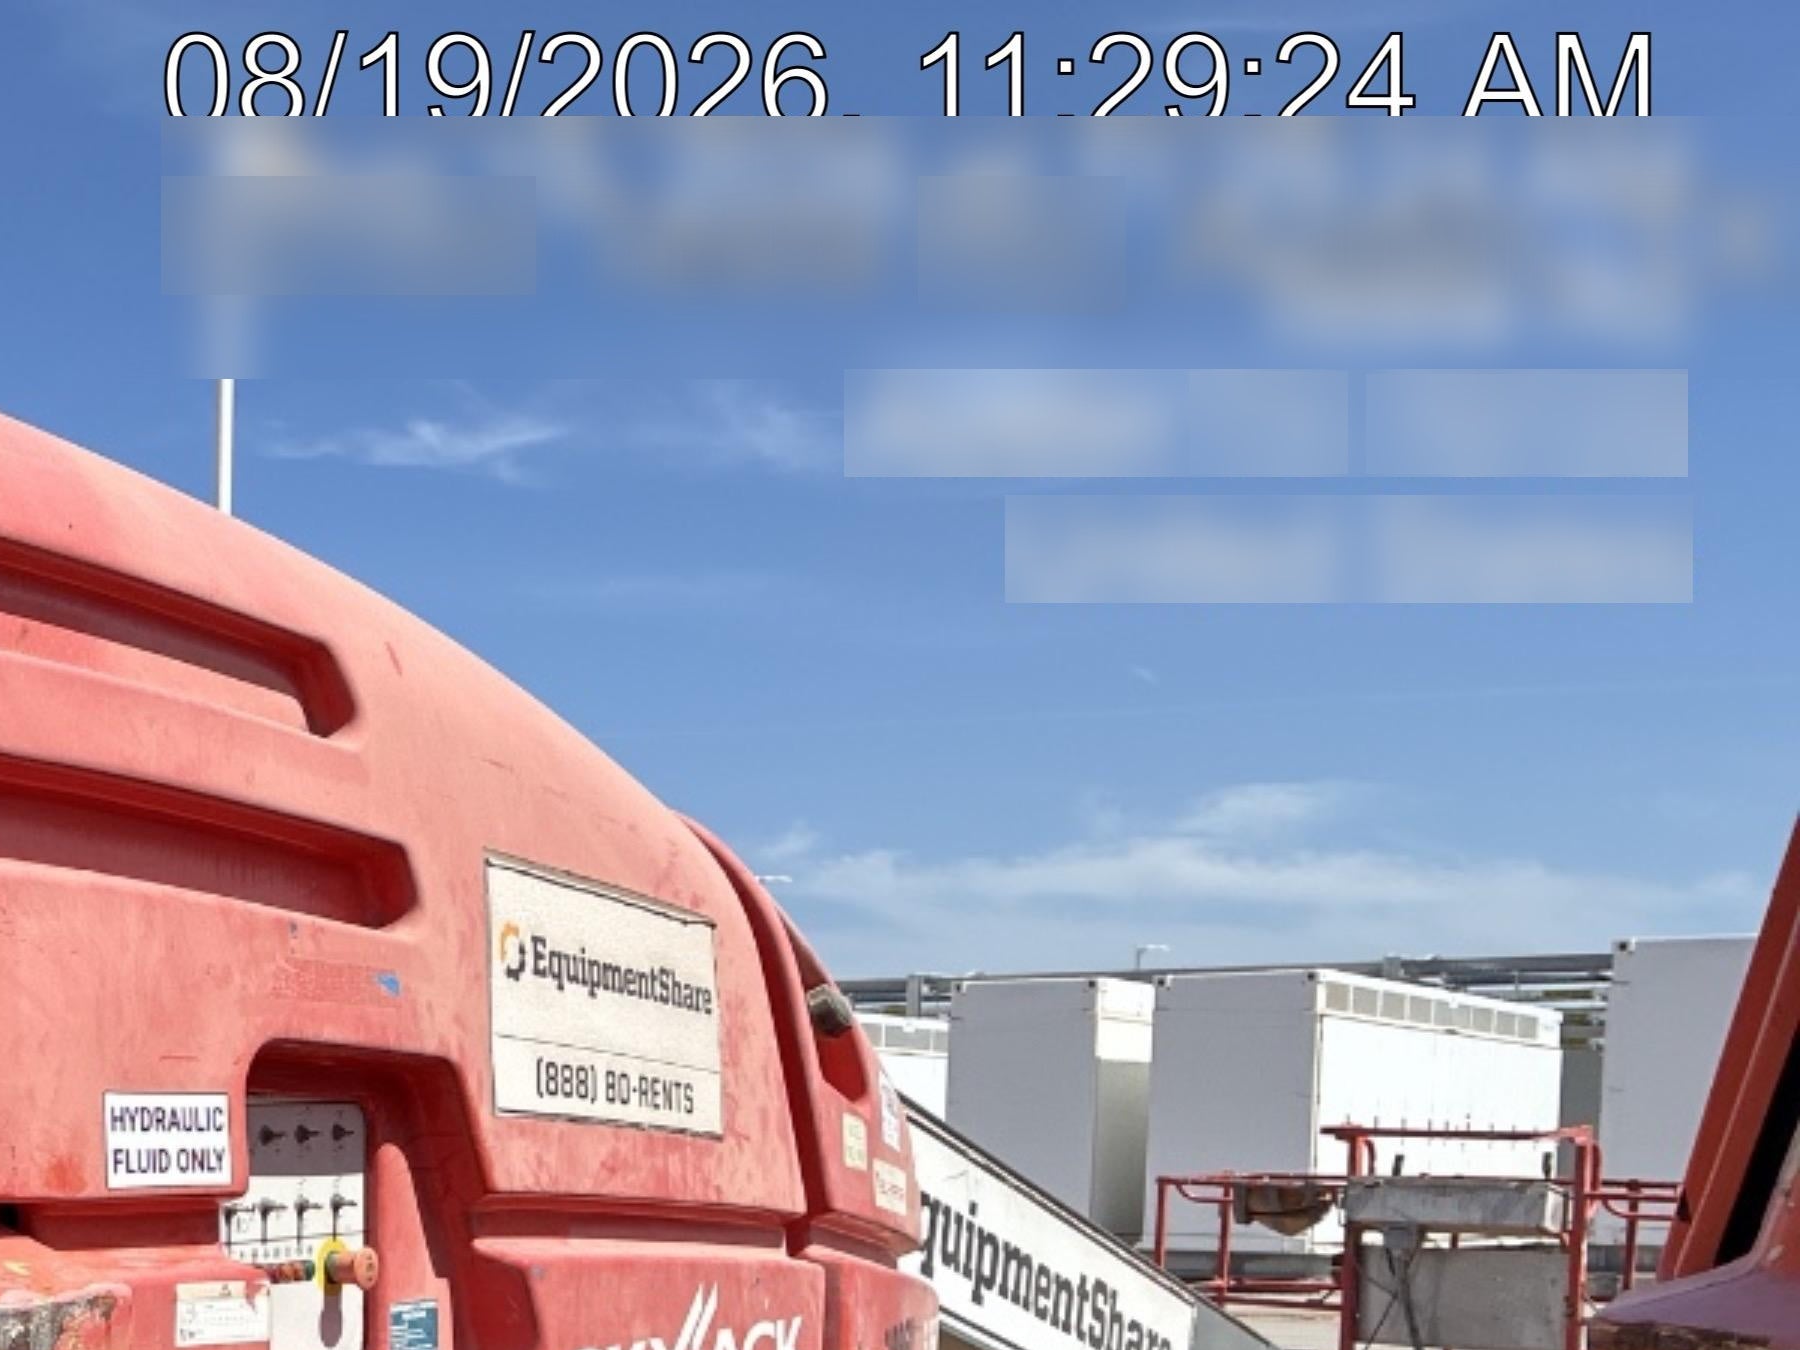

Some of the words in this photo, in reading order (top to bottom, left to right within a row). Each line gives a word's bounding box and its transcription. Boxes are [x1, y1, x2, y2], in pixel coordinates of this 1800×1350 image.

[531, 935, 713, 1015] EquipmentShare
[536, 1056, 598, 1105] (888)
[110, 1105, 224, 1132] HYDRAULIC
[113, 1148, 171, 1174] FLUID
[176, 1147, 225, 1174] ONLY
